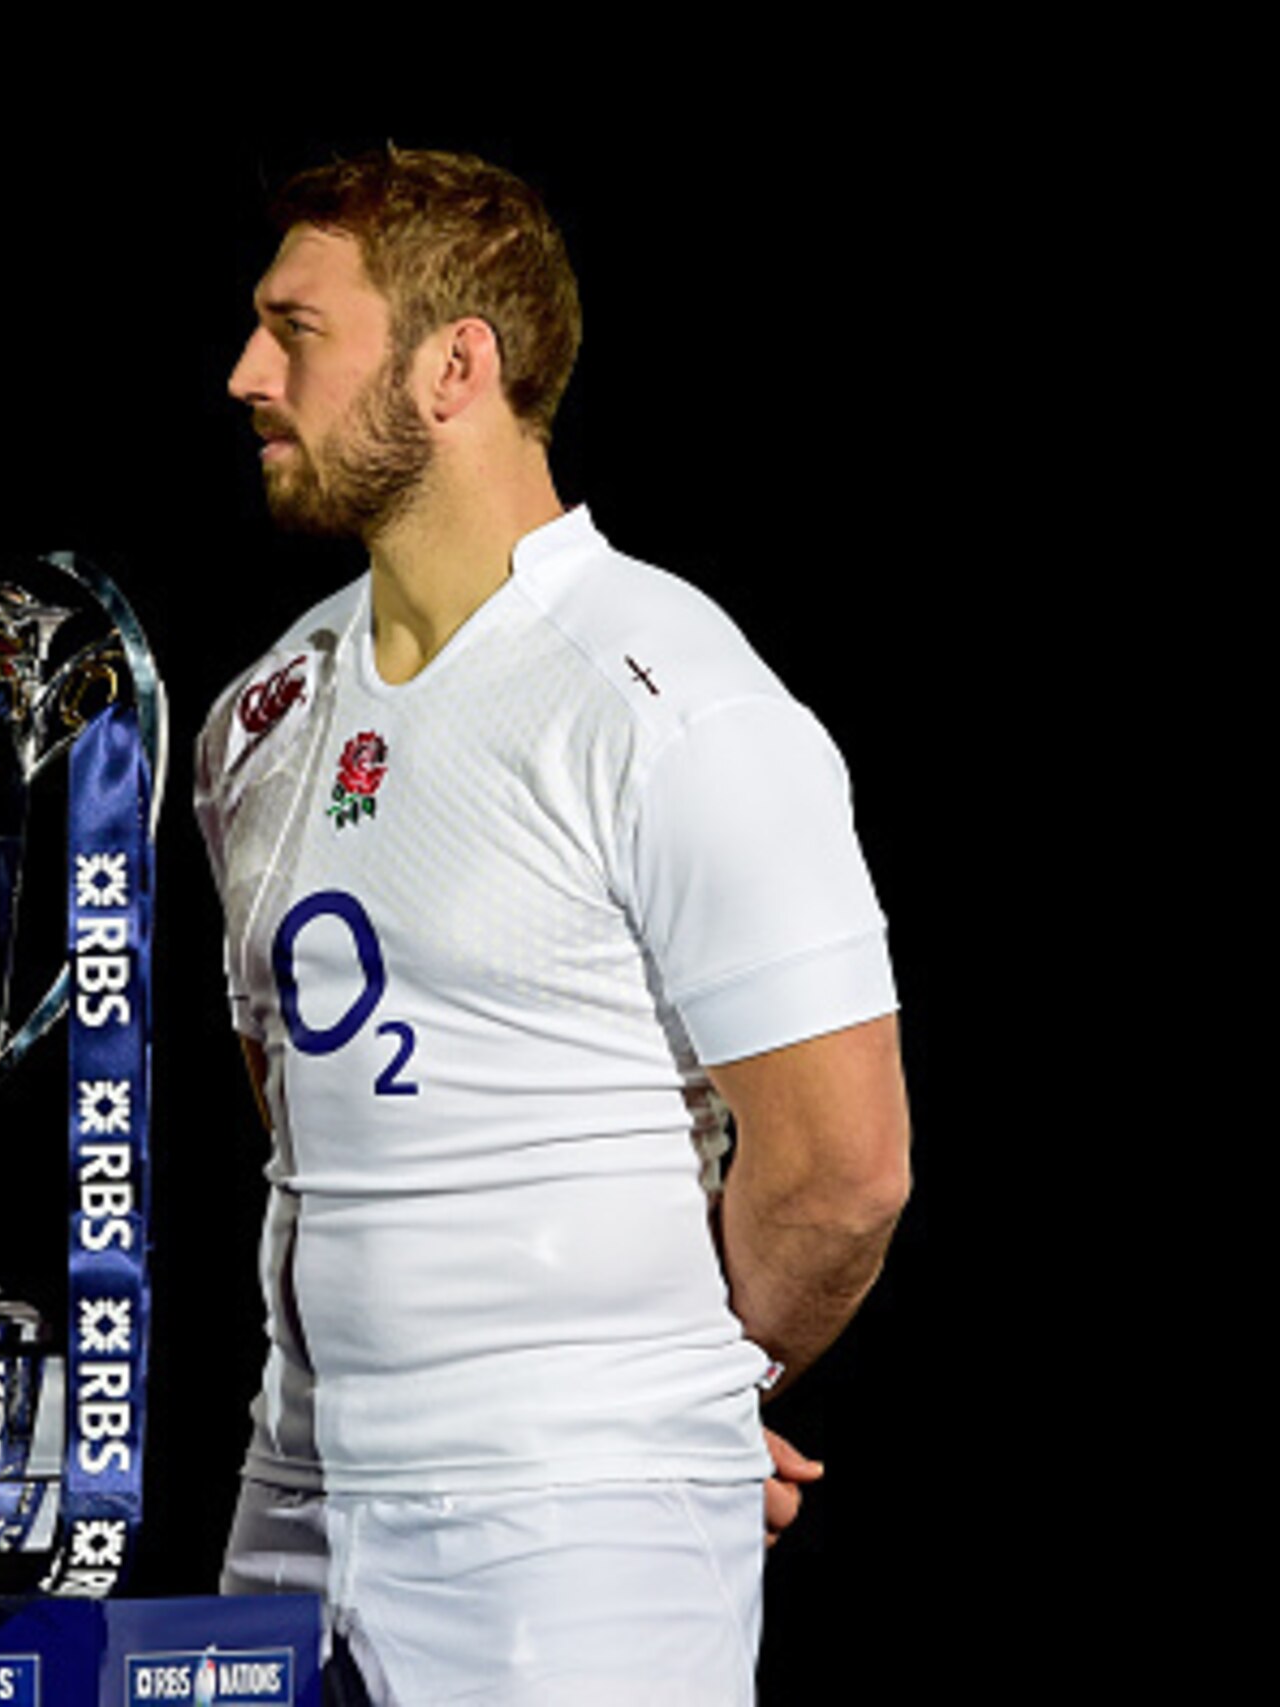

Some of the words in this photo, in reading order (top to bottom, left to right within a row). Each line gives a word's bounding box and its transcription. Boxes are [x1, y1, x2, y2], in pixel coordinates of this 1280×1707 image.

[76, 917, 131, 1028] RBS
[272, 889, 419, 1096] O2
[79, 1144, 133, 1252] RBS
[78, 1363, 131, 1476] RBS
